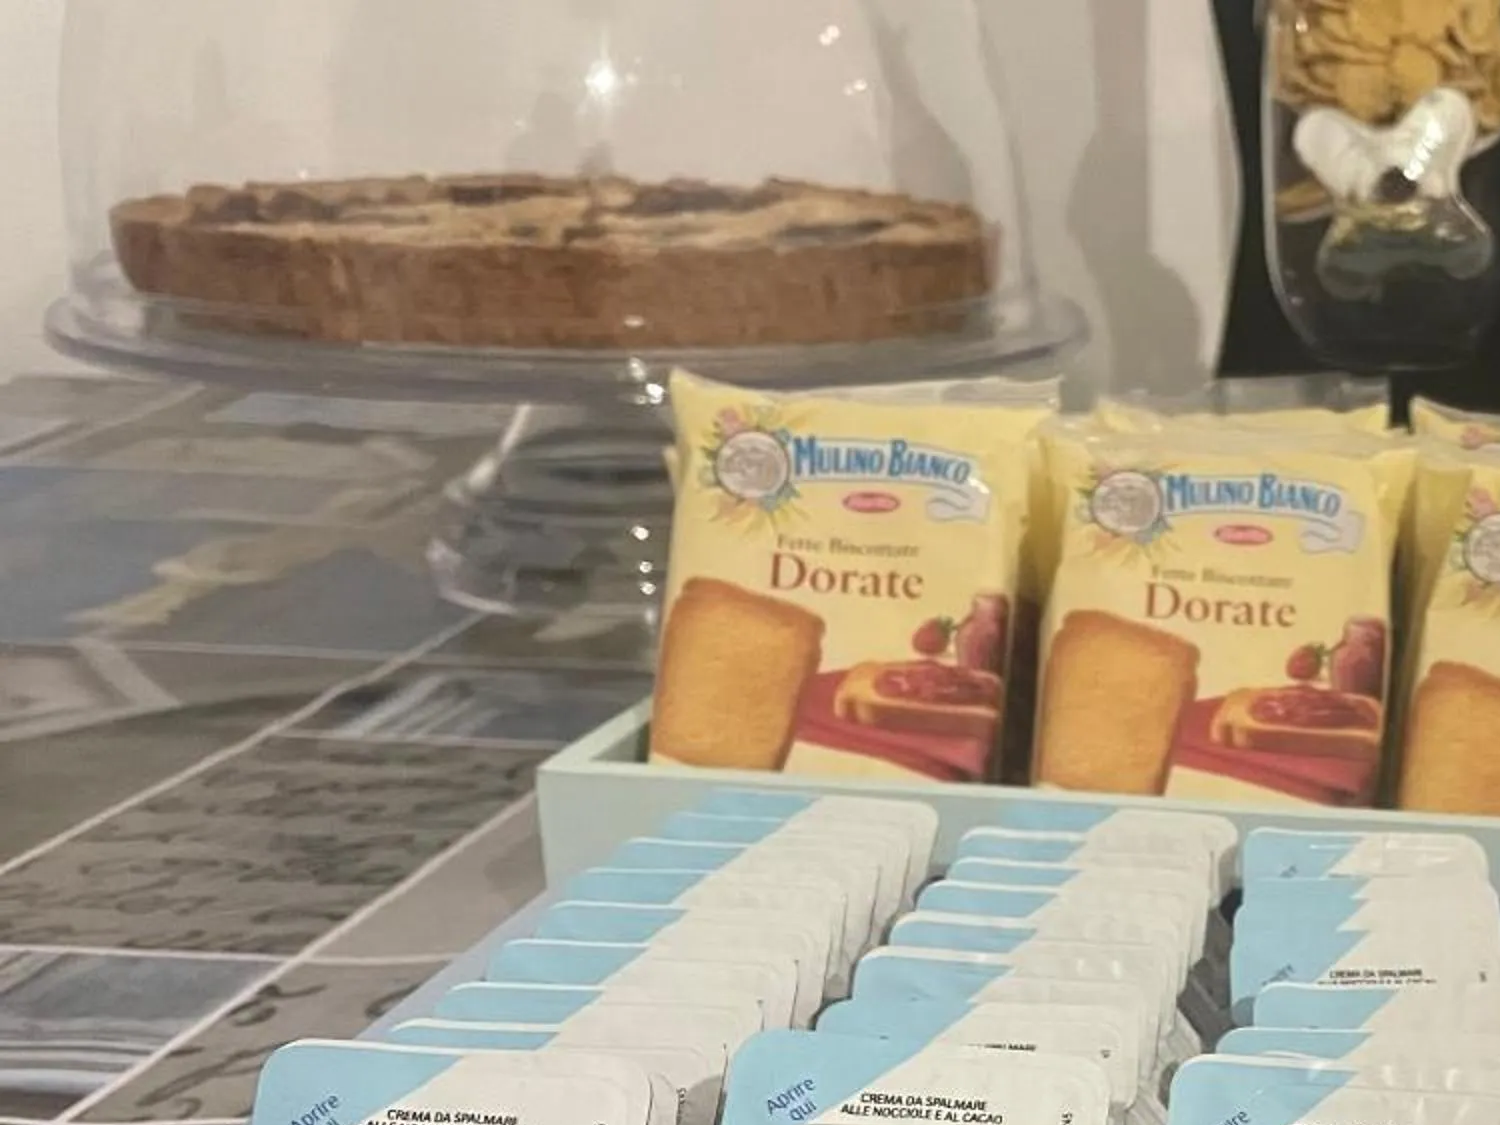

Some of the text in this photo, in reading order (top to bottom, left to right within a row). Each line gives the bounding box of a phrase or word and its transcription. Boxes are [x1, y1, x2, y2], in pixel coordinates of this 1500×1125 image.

[792, 435, 973, 486] MULINO BIANCO
[1164, 471, 1343, 519] MULINO BIANCO
[769, 552, 925, 600] Dorate
[1144, 581, 1297, 628] Dorate
[386, 1108, 432, 1124] CREMA
[434, 1111, 452, 1124] DA
[766, 1078, 816, 1116] Aprire
[789, 1100, 818, 1122] qui
[841, 1104, 870, 1117] ALLE
[872, 1105, 932, 1121] NOCCIOLE
[944, 1110, 960, 1122] AL
[961, 1112, 1003, 1125] CACAO
[860, 1092, 988, 1112] CREMA DA SPALMARE
